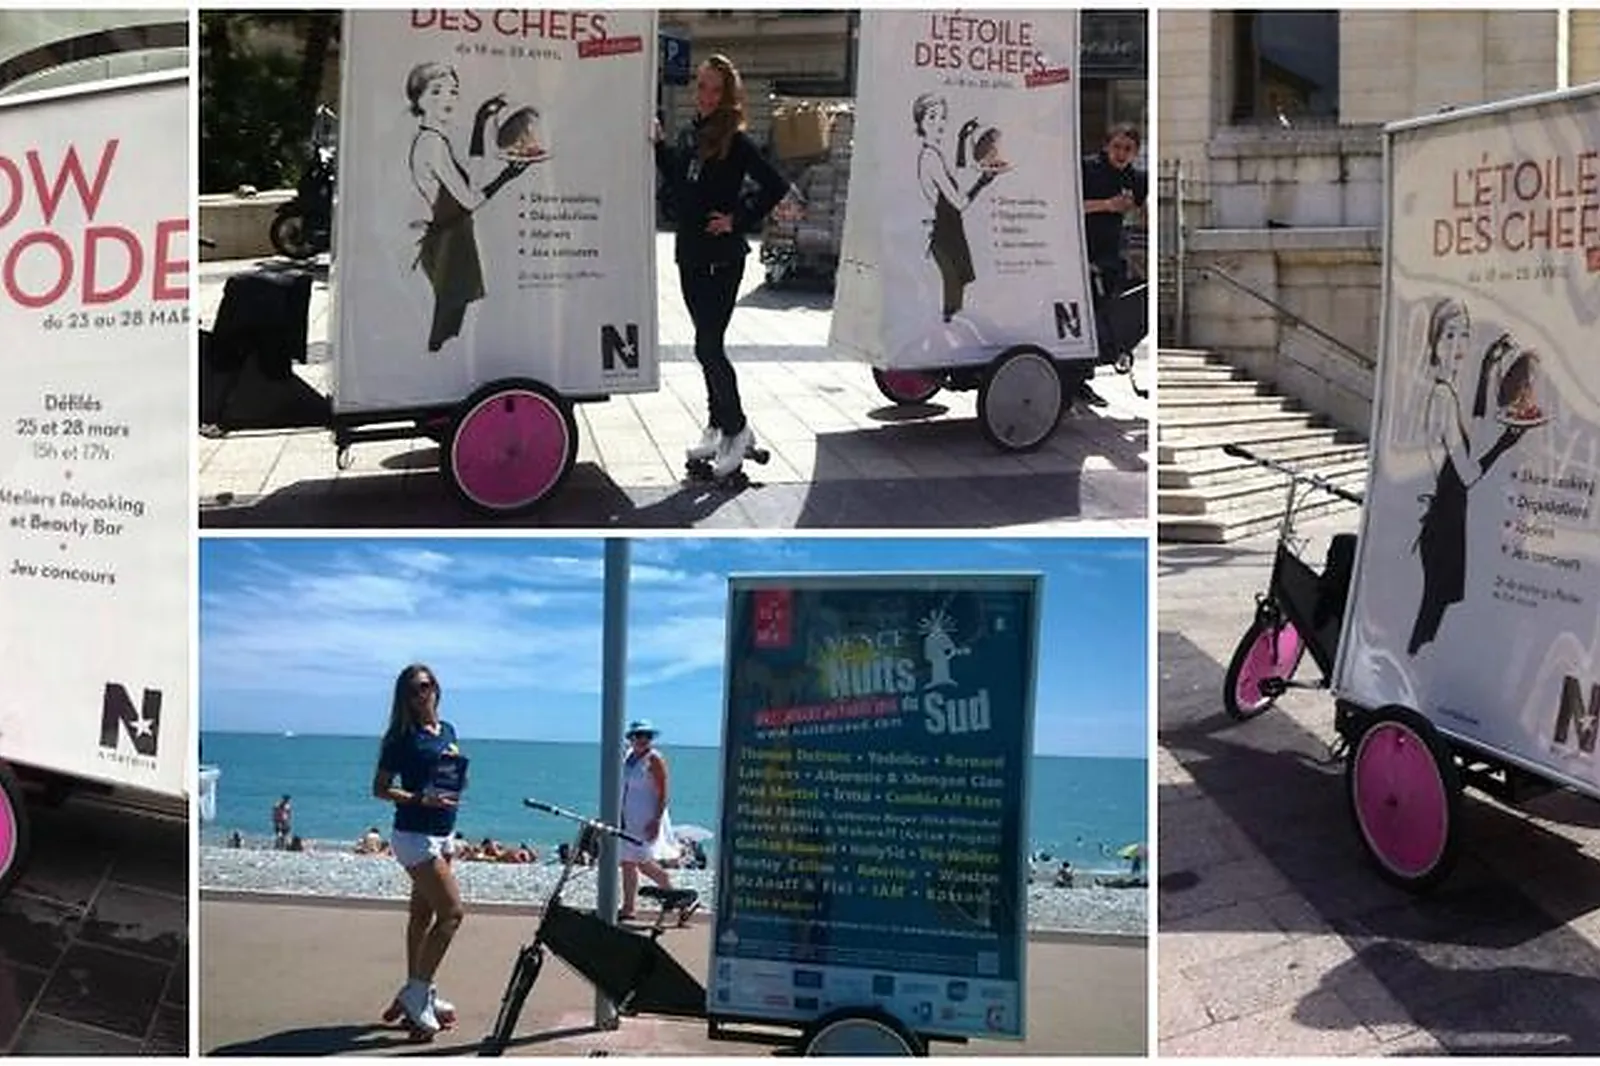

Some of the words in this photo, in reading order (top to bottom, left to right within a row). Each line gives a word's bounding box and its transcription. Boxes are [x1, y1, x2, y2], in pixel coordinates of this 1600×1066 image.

[411, 9, 482, 32] DES
[493, 9, 608, 41] CHEFS
[931, 9, 1033, 47] L'ÉTOILE
[667, 40, 679, 60] P
[914, 43, 962, 69] DES
[967, 46, 1047, 74] CHEFS
[1453, 152, 1598, 208] L'ÉTOILE
[1433, 215, 1493, 257] DES
[1502, 203, 1600, 252] CHEF
[93, 314, 115, 327] au
[119, 310, 143, 325] 28
[1054, 301, 1082, 340] N
[601, 324, 639, 370] N
[16, 418, 38, 436] 25
[41, 421, 58, 436] et
[62, 419, 85, 436] 28
[88, 423, 130, 437] mars
[62, 444, 78, 460] et
[60, 491, 145, 517] Relooking
[10, 515, 26, 527] et
[30, 514, 88, 536] Beauty
[93, 518, 125, 536] Bar
[10, 559, 38, 576] Jeu
[41, 564, 116, 585] concours
[99, 682, 163, 757] N
[925, 689, 992, 735] Sud
